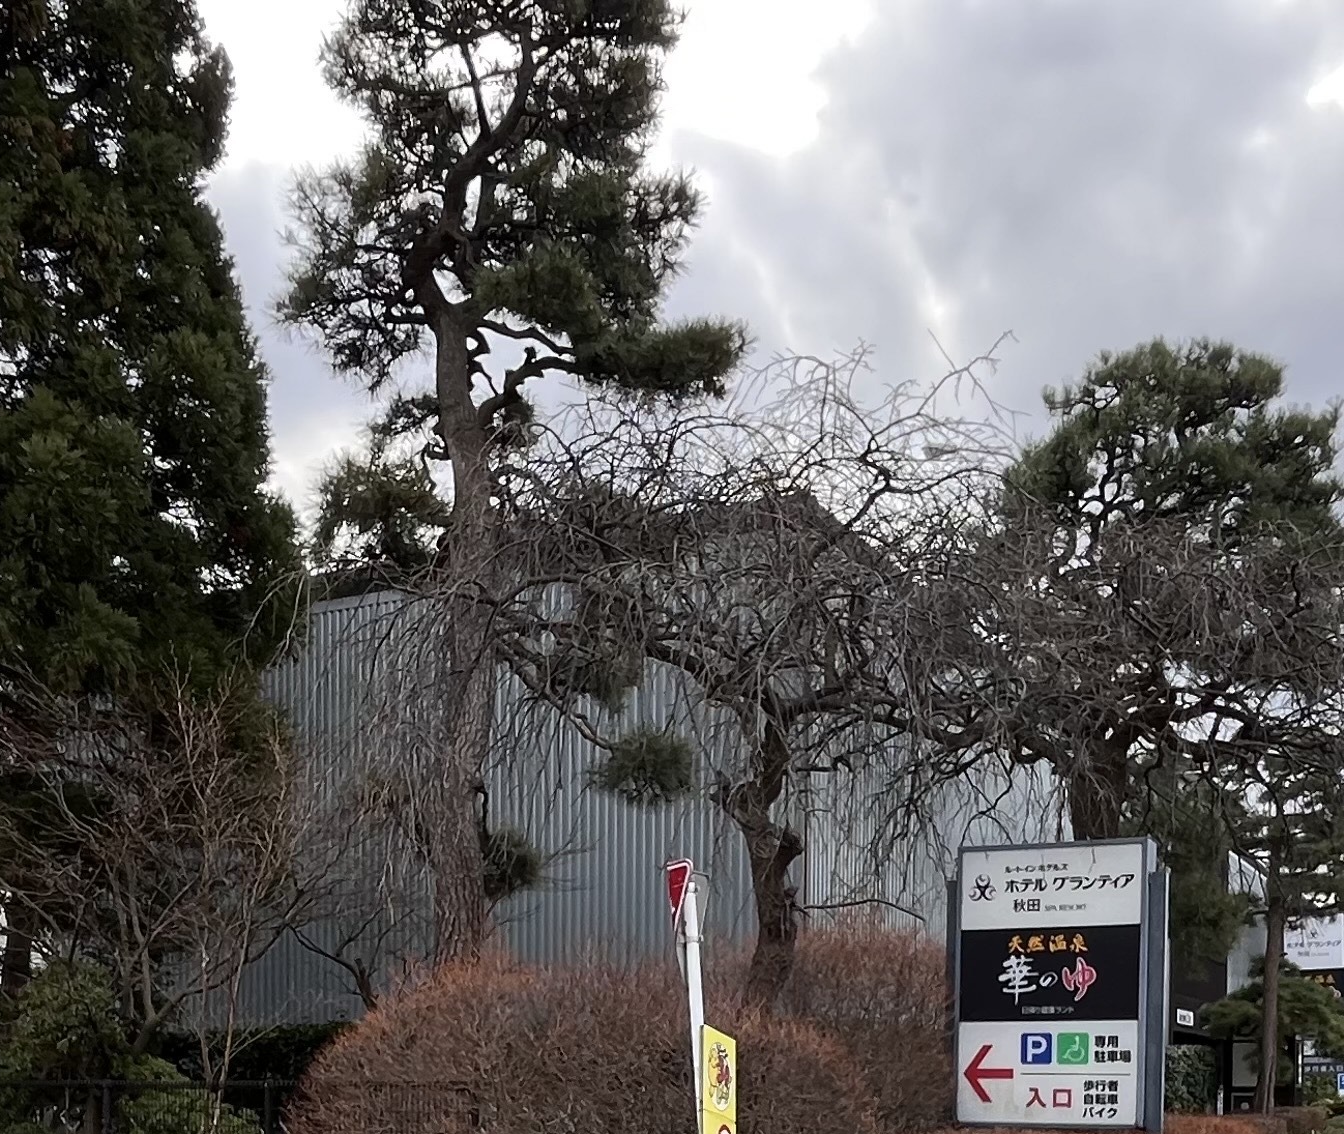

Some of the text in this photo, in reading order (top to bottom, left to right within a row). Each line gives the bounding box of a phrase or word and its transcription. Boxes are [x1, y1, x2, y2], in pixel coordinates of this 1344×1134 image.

[1004, 873, 1136, 893] ホテル グランティア
[1012, 899, 1041, 912] 秋田
[1008, 933, 1088, 953] 天然温泉
[998, 954, 1097, 1006] 華のゆ
[1026, 1035, 1048, 1062] P
[1093, 1035, 1119, 1048] 専用
[1093, 1049, 1132, 1063] 駐車場
[1082, 1080, 1119, 1093] 歩行者
[1025, 1086, 1072, 1109] 入口
[1083, 1093, 1119, 1105] 自転車
[1081, 1106, 1118, 1119] バイク
